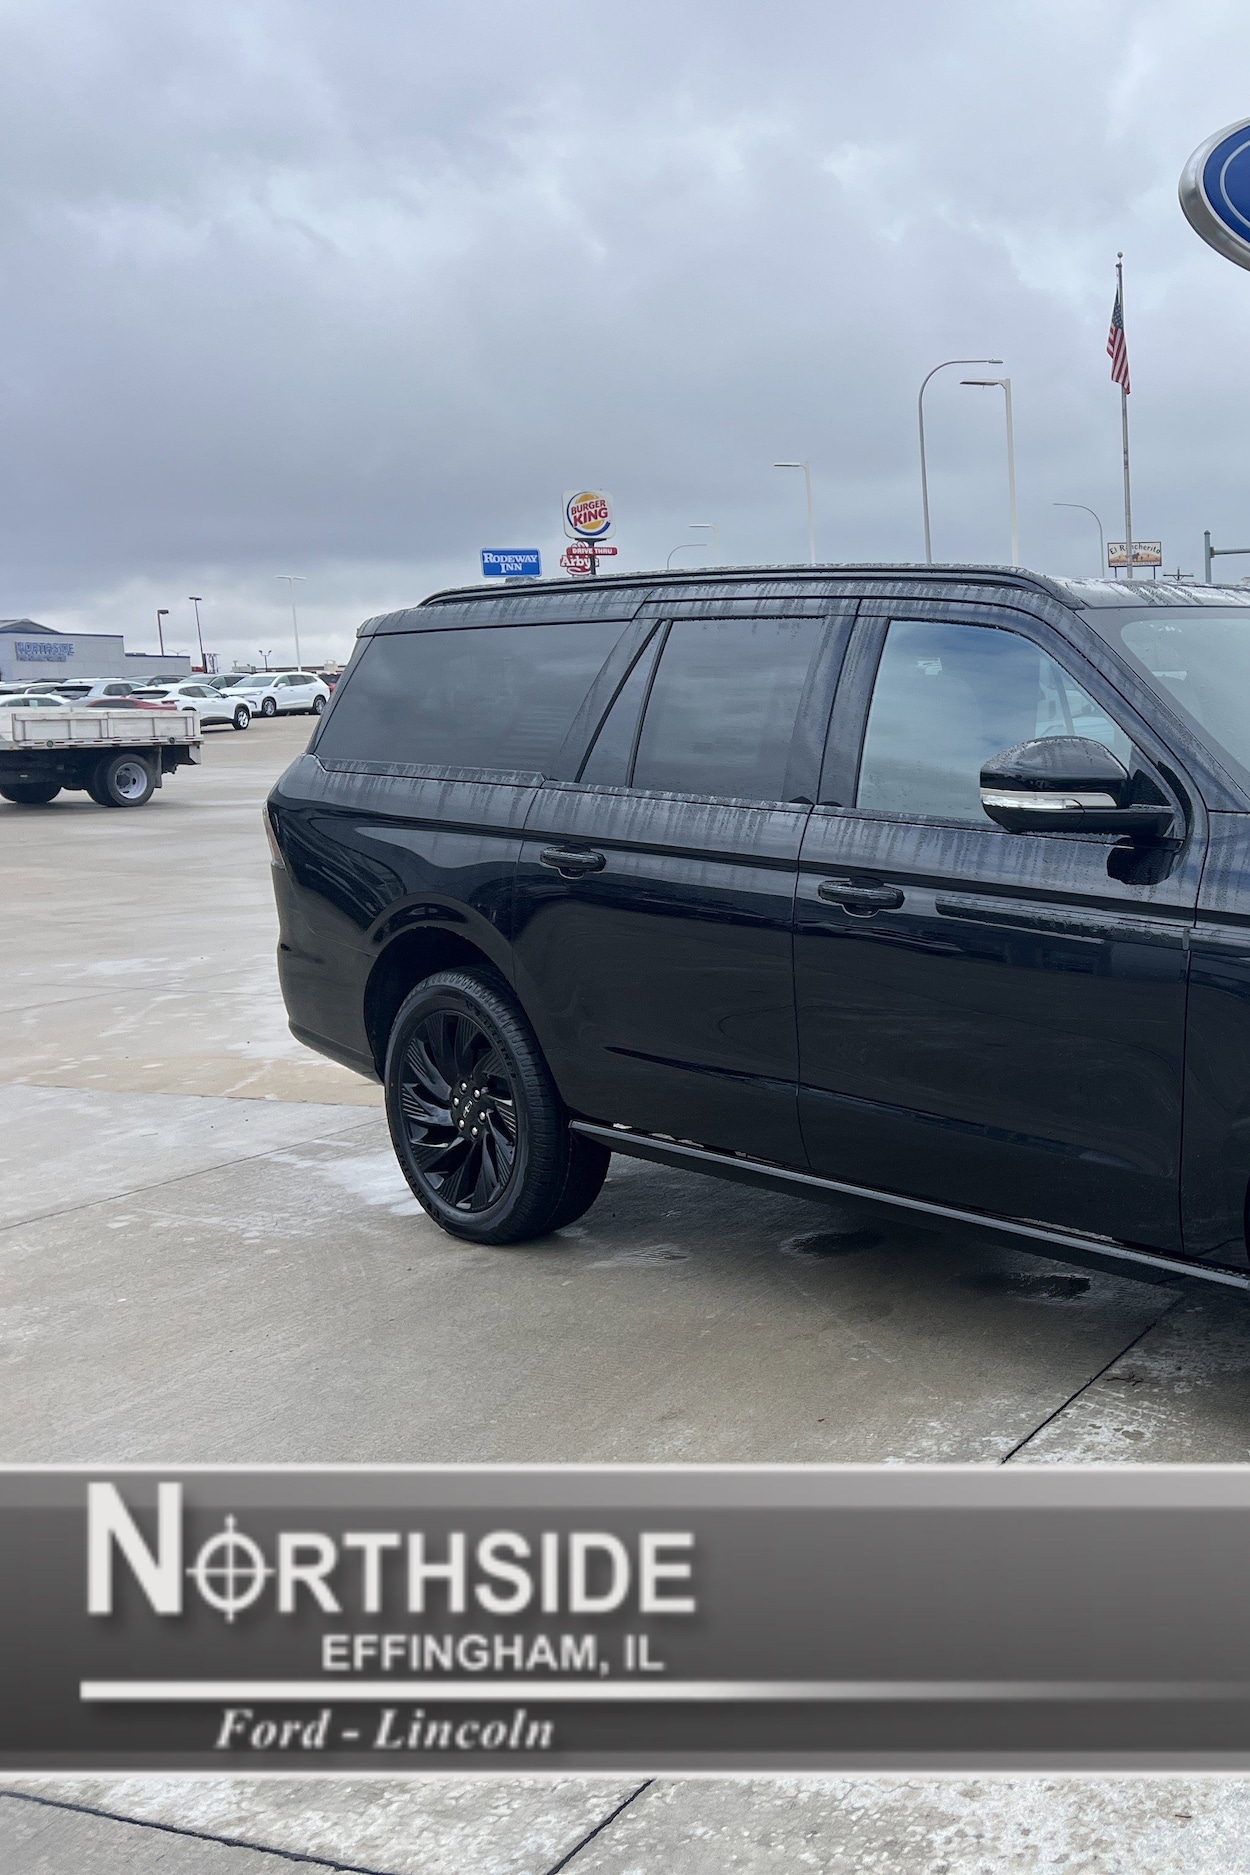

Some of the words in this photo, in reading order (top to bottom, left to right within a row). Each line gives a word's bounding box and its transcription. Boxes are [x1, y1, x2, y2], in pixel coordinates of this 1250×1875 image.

[571, 499, 606, 516] BURGER
[573, 507, 609, 527] KING
[594, 547, 613, 555] THRU
[1109, 546, 1118, 555] El
[1119, 543, 1161, 554] Rncherito
[483, 552, 538, 564] RODEWAY
[500, 563, 523, 574] INN
